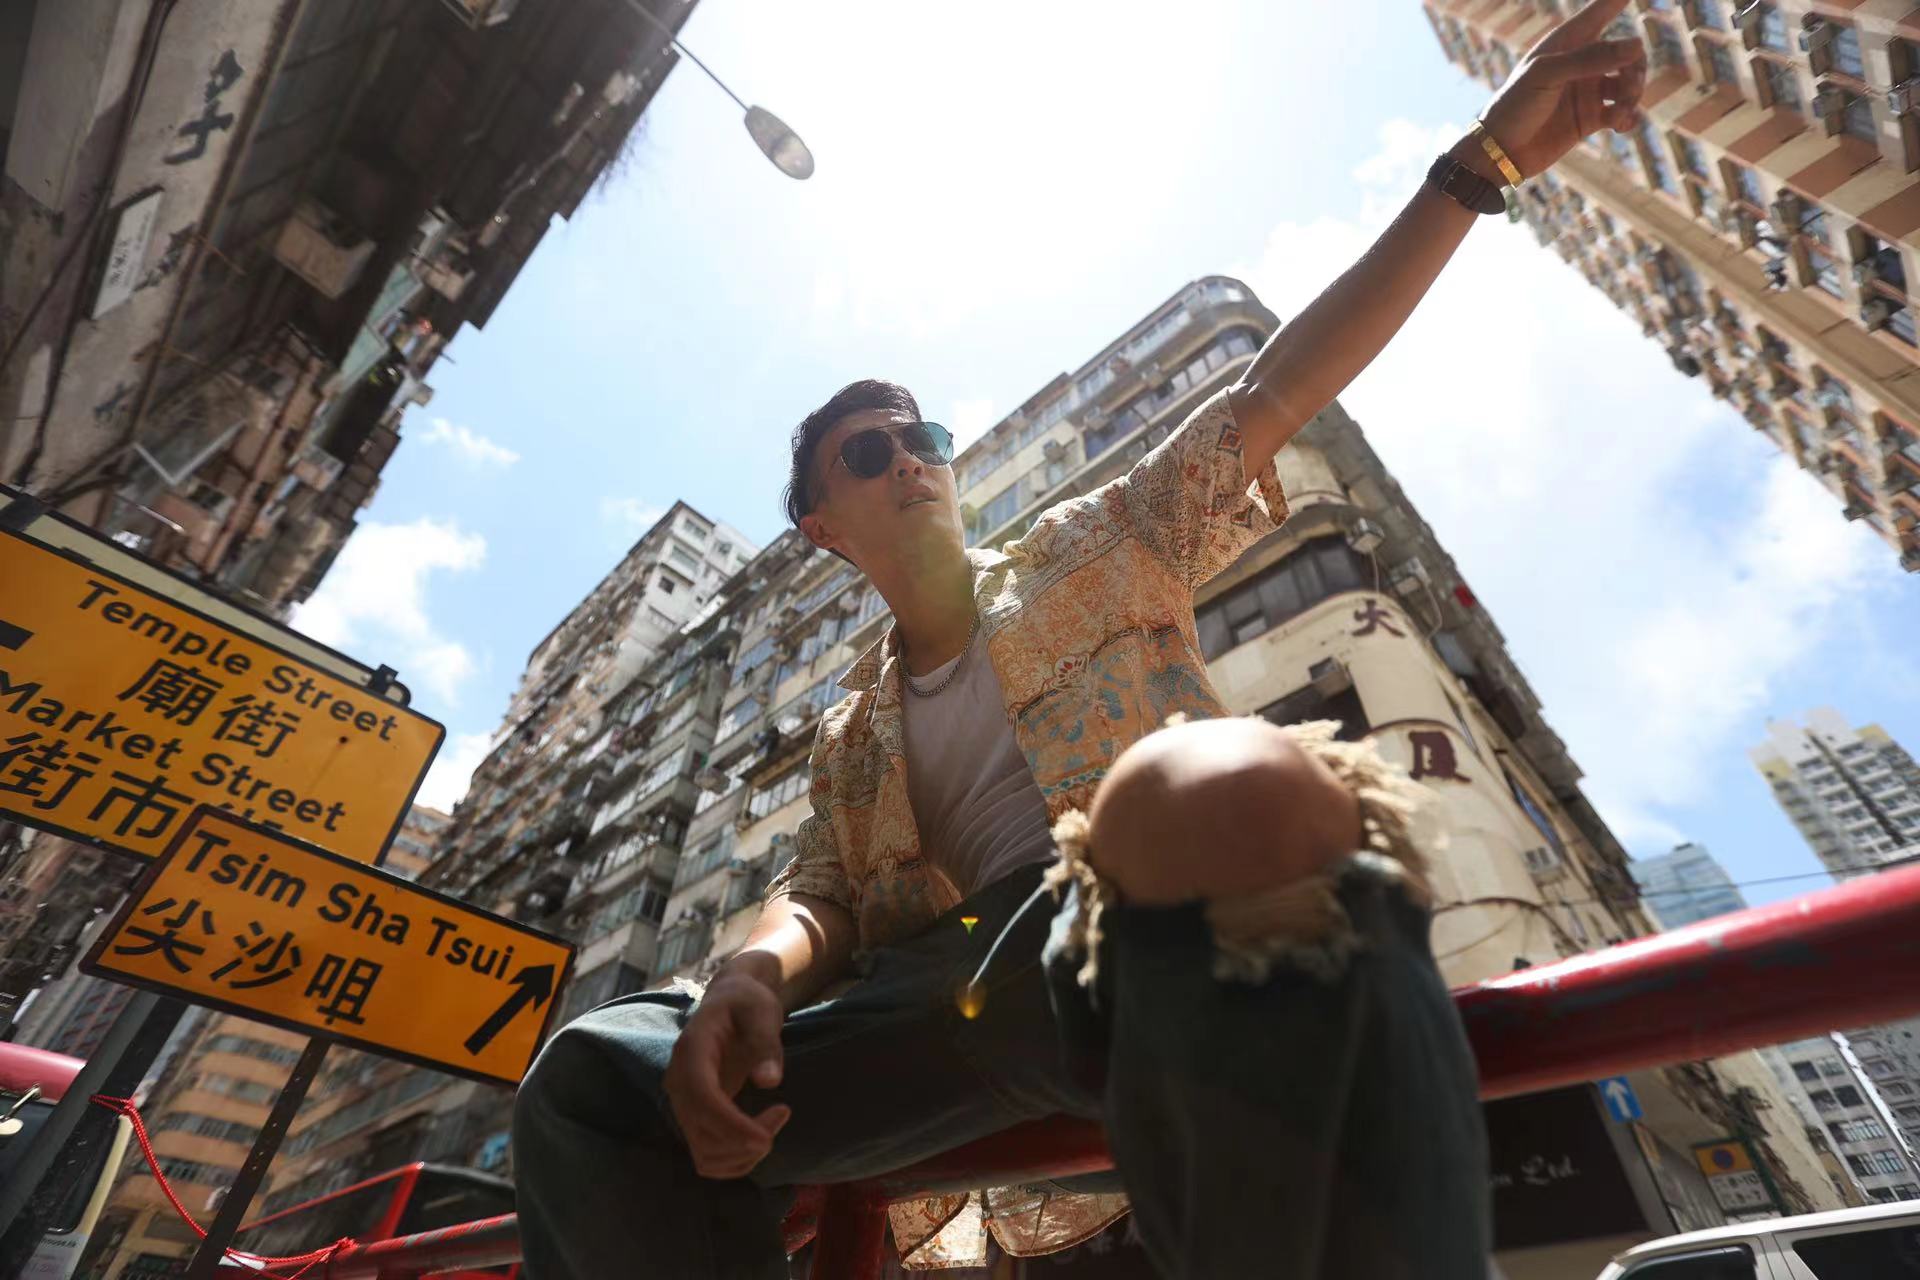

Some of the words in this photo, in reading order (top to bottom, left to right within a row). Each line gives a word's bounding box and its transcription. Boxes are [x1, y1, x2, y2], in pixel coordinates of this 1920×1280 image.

[78, 579, 252, 676] Temple
[263, 665, 397, 742] Street
[117, 657, 299, 758] 廟街
[0, 669, 182, 769] Market
[192, 752, 346, 832] Street
[113, 897, 383, 1026] 尖沙咀
[185, 830, 307, 908] Tsim
[317, 882, 411, 945] Sha
[427, 917, 513, 981] Tsui
